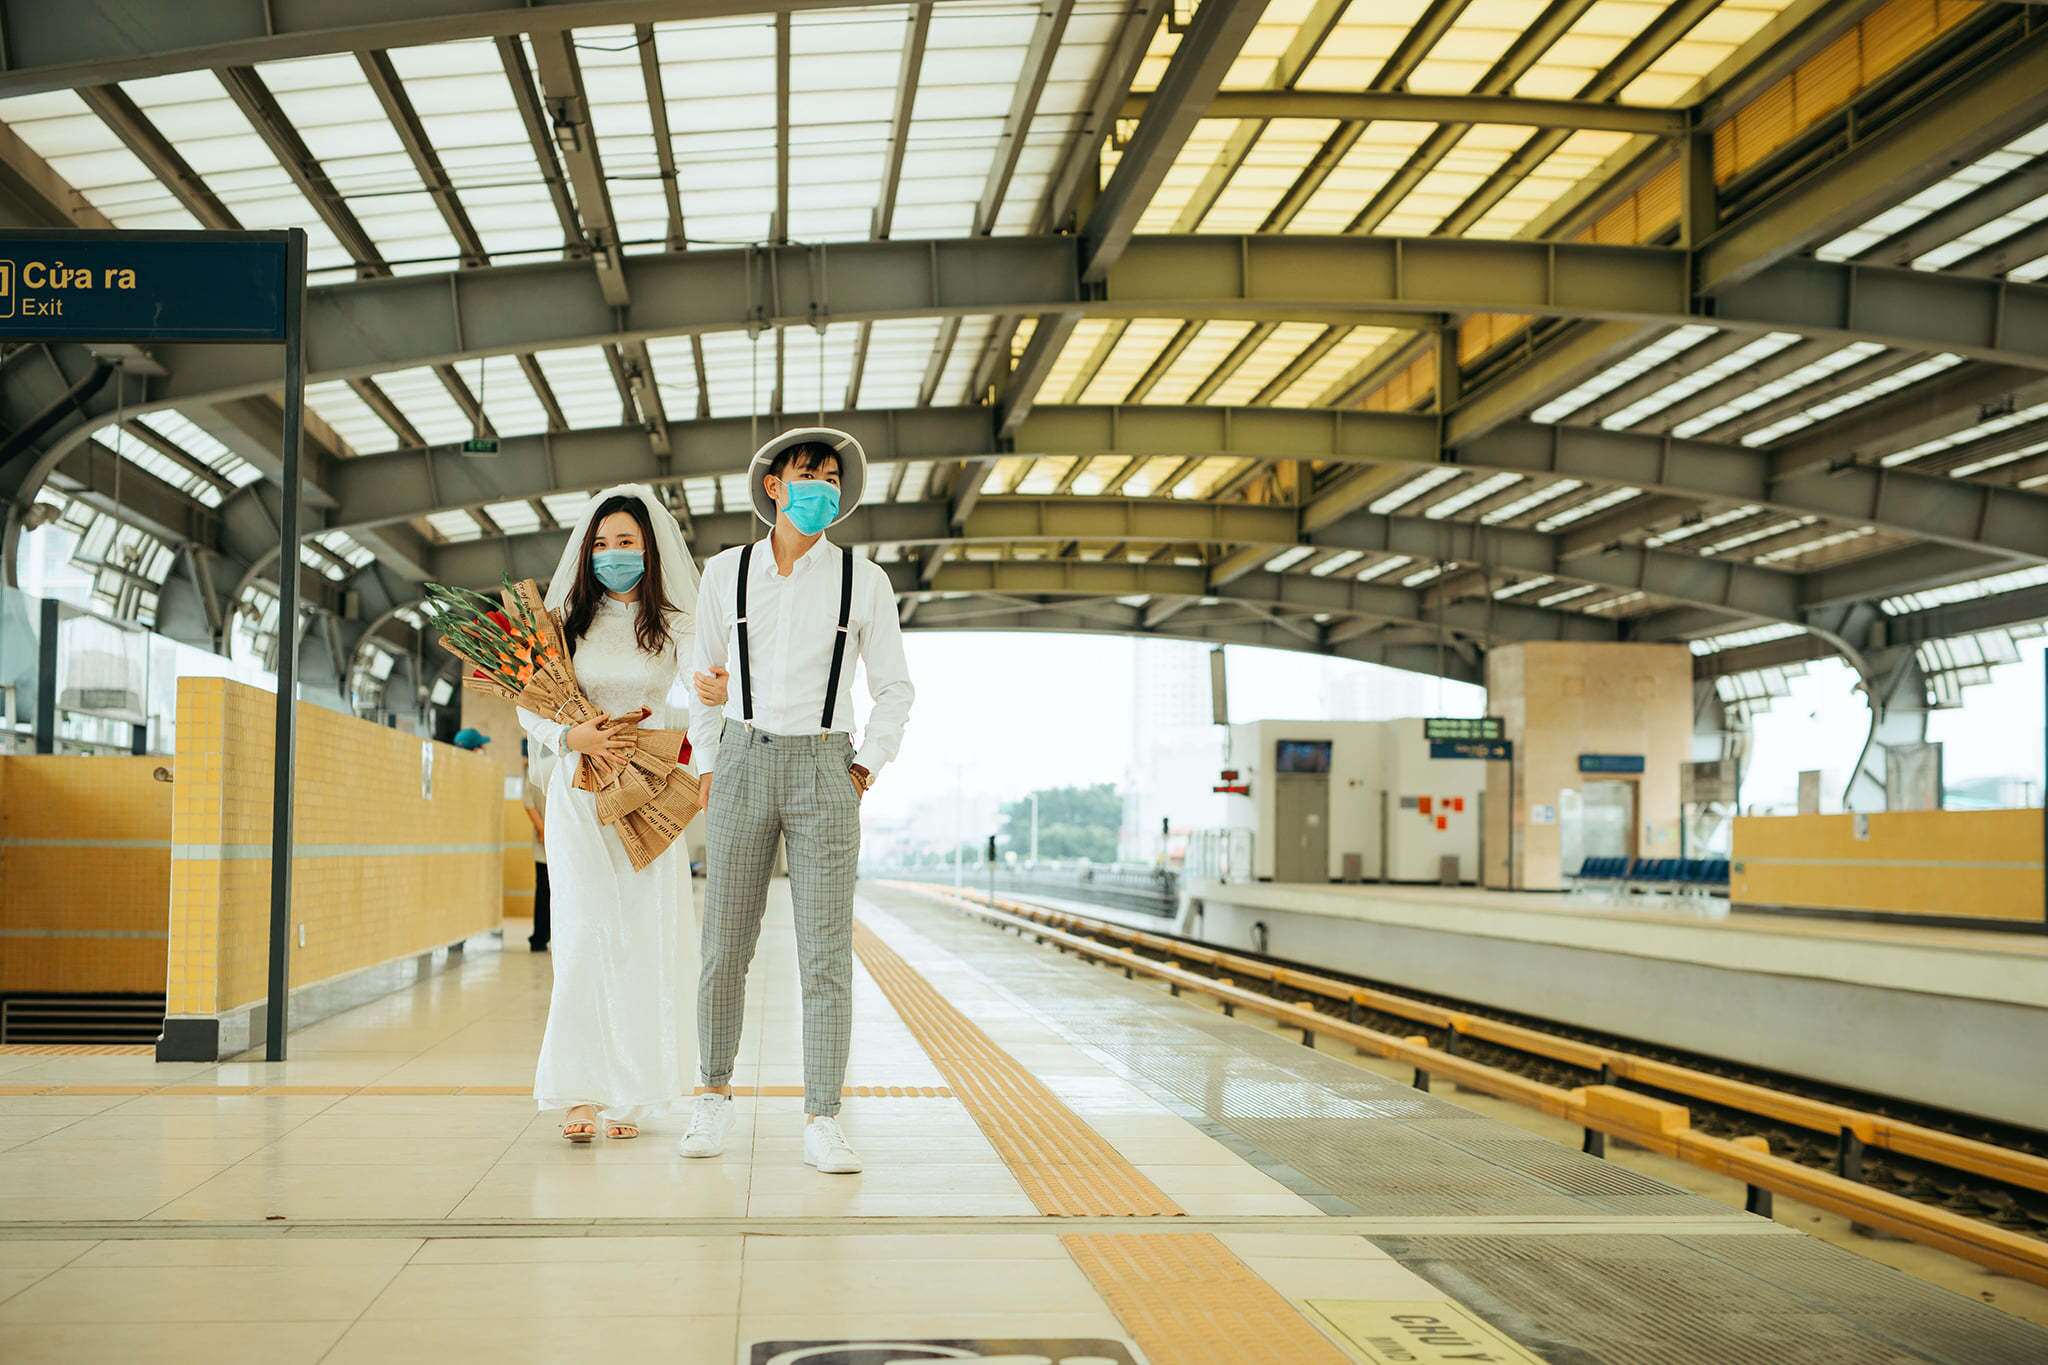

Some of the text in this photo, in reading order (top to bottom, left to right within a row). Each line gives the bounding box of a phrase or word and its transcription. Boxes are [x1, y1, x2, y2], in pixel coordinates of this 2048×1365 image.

[22, 260, 136, 289] Cửa ra
[22, 298, 63, 316] Exit
[1389, 1314, 1483, 1347] CHÚ
